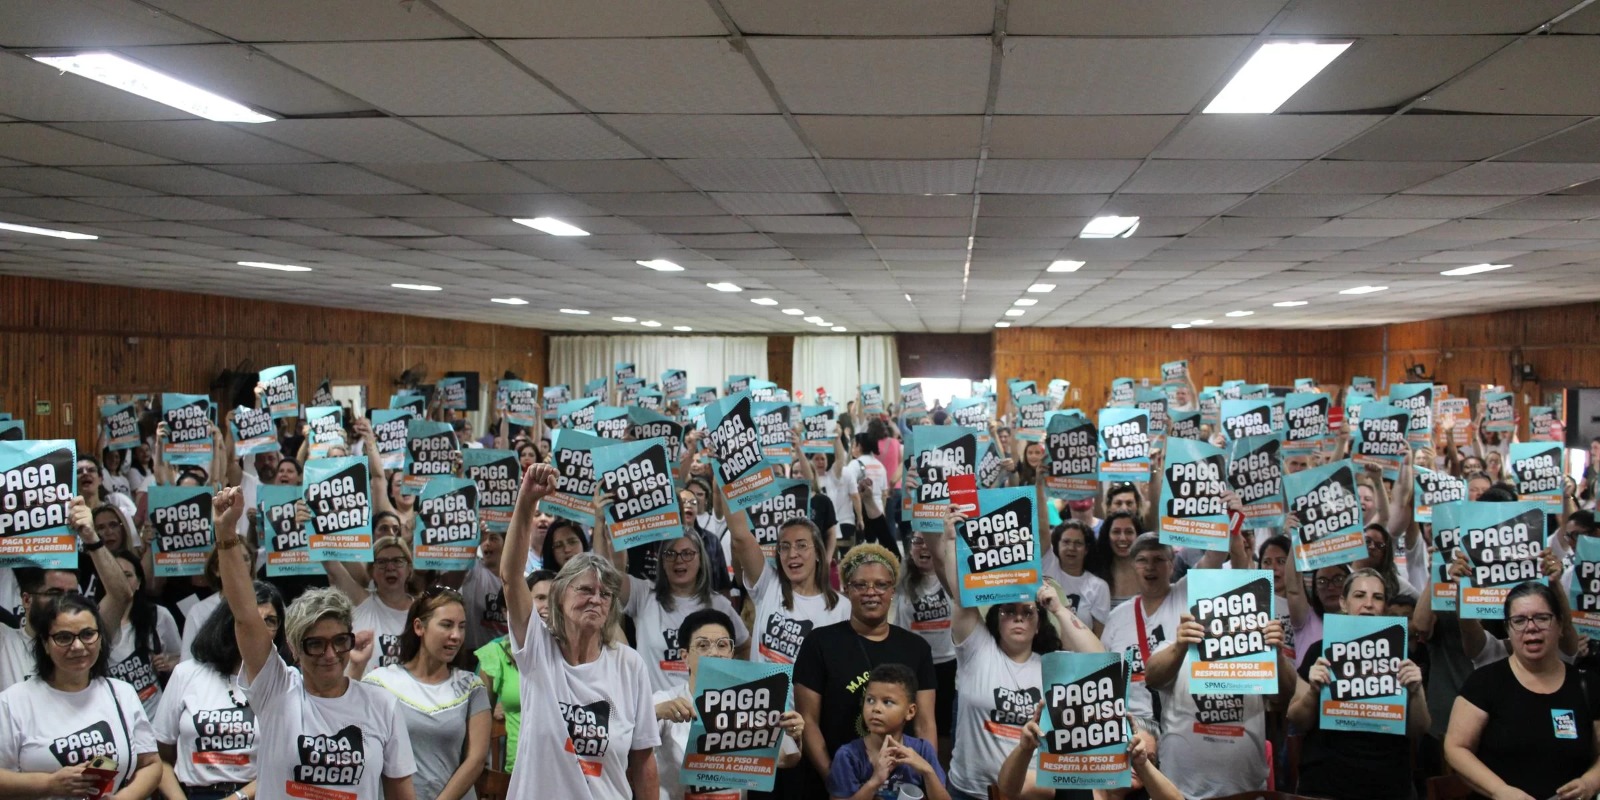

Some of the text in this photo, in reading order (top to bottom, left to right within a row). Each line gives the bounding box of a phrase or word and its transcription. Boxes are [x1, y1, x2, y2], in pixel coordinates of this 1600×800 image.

[1227, 412, 1263, 430] PAGA
[1289, 405, 1320, 420] PAGA
[175, 420, 182, 429] O
[598, 419, 627, 431] PAGA
[635, 424, 671, 439] PAGA
[711, 414, 745, 449] PAGA
[1105, 421, 1140, 438] PAGA
[1290, 422, 1324, 440] PAGA!
[1363, 419, 1398, 432] PAGA
[1051, 431, 1088, 448] PAGA
[1112, 437, 1119, 446] O
[1234, 429, 1242, 439] O
[1369, 432, 1376, 441] O
[412, 437, 449, 451] PAGA
[1108, 443, 1149, 461] PAGA!
[419, 451, 427, 461] O
[722, 441, 762, 481] PAGA!
[921, 447, 965, 468] PAGA
[1058, 447, 1065, 459] O
[566, 465, 575, 476] O
[1053, 456, 1097, 475] PAGA!
[1229, 452, 1269, 476] PAGA
[1516, 455, 1553, 471] PAGA
[470, 465, 508, 480] PAGA
[604, 459, 654, 490] PAGA
[928, 469, 936, 480] O
[1172, 463, 1219, 482] PAGA
[1237, 474, 1247, 486] O
[1525, 470, 1532, 480] O
[309, 476, 355, 501] PAGA
[478, 480, 485, 490] O
[617, 473, 670, 500] O PISO,
[1180, 482, 1190, 496] O
[1520, 476, 1561, 494] PAGA!
[5, 493, 17, 510] O
[319, 492, 368, 513] O PISO,
[423, 494, 468, 515] PAGA
[615, 485, 673, 519] PAGA!
[1296, 481, 1343, 511] PAGA
[156, 503, 200, 524] PAGA
[317, 506, 370, 532] PAGA!
[431, 514, 439, 526] O
[760, 513, 769, 526] O
[1306, 508, 1317, 521] O
[165, 523, 174, 535] O
[282, 520, 290, 532] O
[622, 519, 639, 528] PAGA
[966, 511, 1018, 538] PAGA
[1303, 507, 1358, 542] PAGA!
[162, 530, 211, 551] PAGA!
[426, 523, 478, 543] PAGA!
[978, 527, 1034, 549] O PISO,
[1470, 523, 1528, 549] PAGA
[974, 541, 1034, 571] PAGA!
[1481, 549, 1493, 563] O
[1476, 558, 1543, 585] PAGA!
[1198, 592, 1257, 620] PAGA
[771, 626, 780, 636] O
[1211, 619, 1223, 635] O
[1332, 638, 1390, 662] PAGA
[1343, 661, 1355, 677] O
[705, 688, 770, 712] PAGA
[998, 687, 1033, 705] PAGA
[1053, 677, 1114, 708] PAGA
[1002, 701, 1011, 710] O
[1205, 701, 1212, 710] O
[197, 711, 244, 723] PAGA
[716, 712, 729, 730] O
[1062, 708, 1076, 726] O
[205, 723, 215, 734] O
[574, 725, 609, 740] PISO,
[1055, 716, 1128, 751] PAGA!
[55, 730, 104, 753] PAGA
[200, 734, 255, 750] PAGA!
[303, 736, 352, 752] PAGA
[704, 727, 781, 751] PAGA!
[574, 739, 609, 757] GA!
[67, 751, 79, 763] O
[310, 751, 365, 765] O PISO,
[1058, 755, 1080, 763] PAGA
[1089, 755, 1108, 763] PISO
[300, 765, 365, 784] PAGA!
[689, 762, 772, 773] RESPEITA CARREIRA
[1043, 762, 1127, 771] RESPEITA CARREIRA
